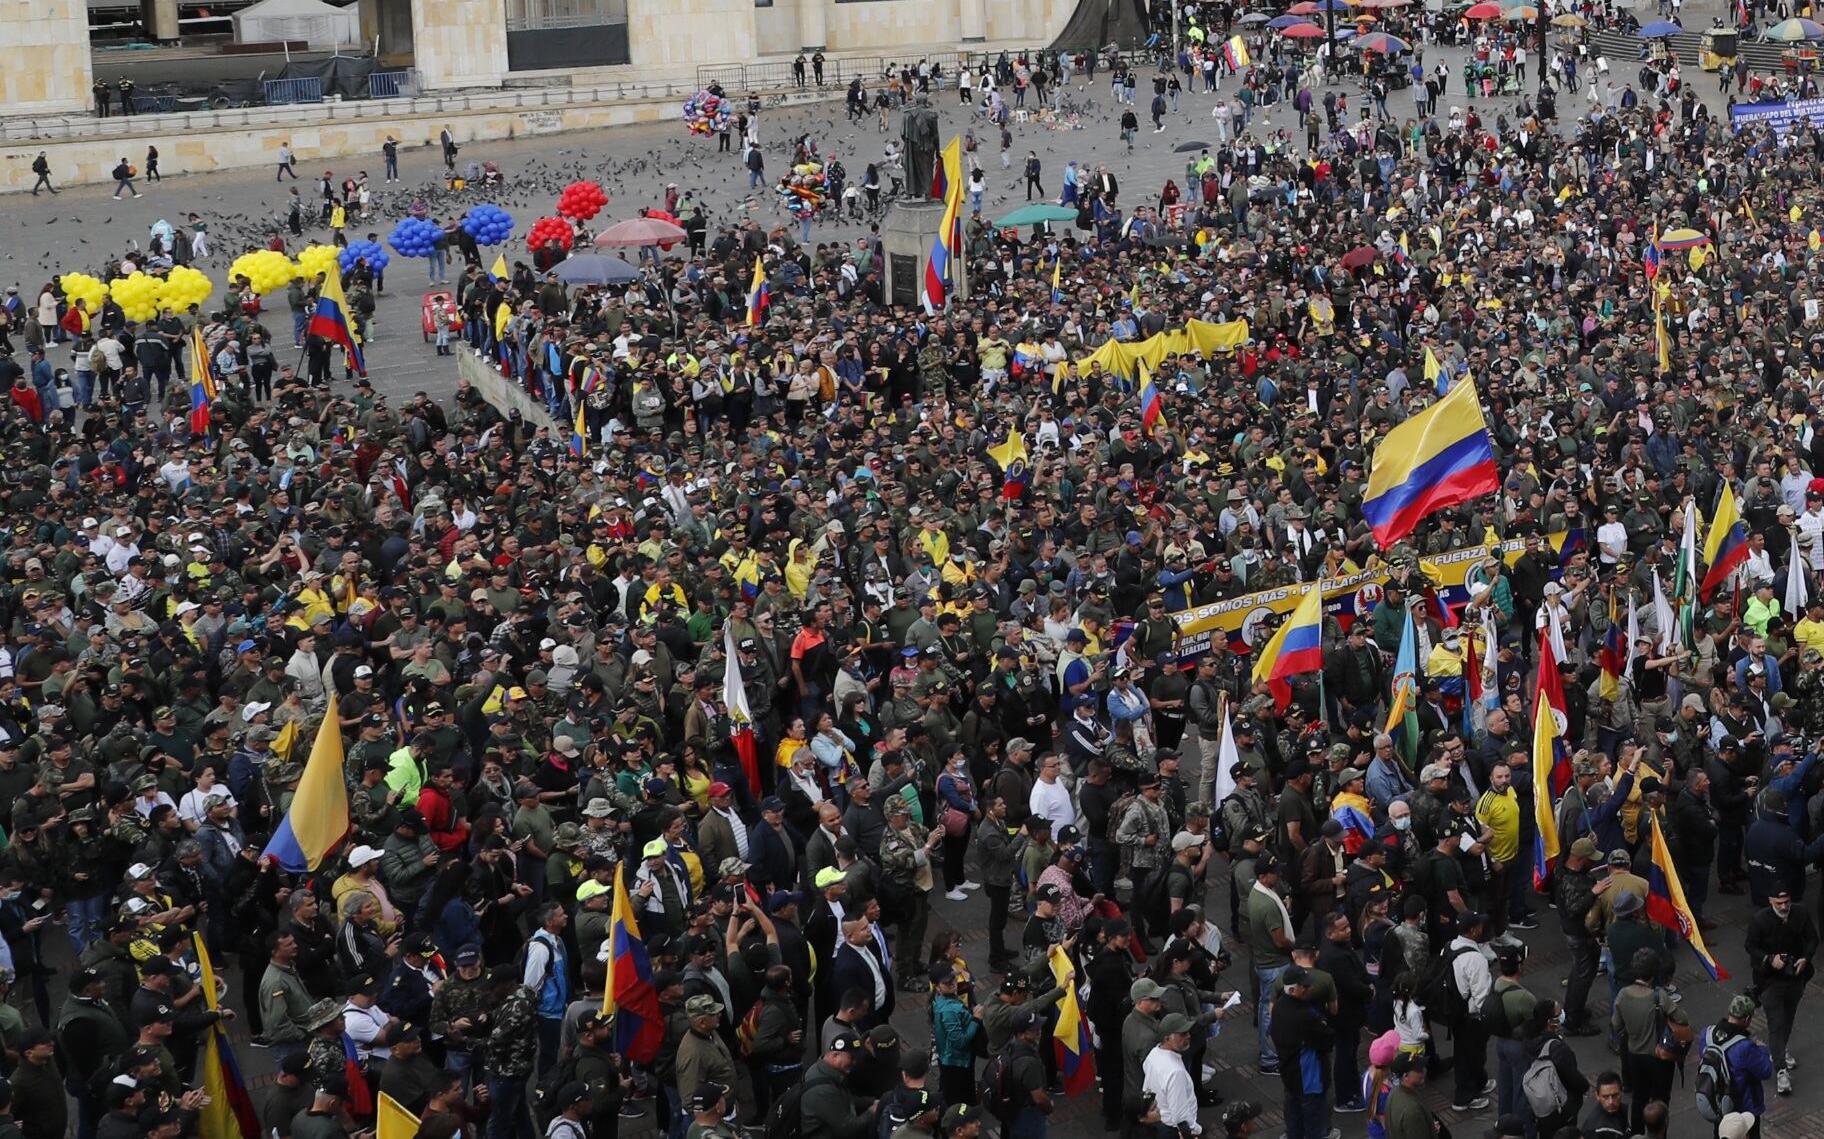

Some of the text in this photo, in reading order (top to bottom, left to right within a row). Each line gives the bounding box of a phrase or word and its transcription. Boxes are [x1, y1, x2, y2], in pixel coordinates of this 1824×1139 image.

[1198, 596, 1253, 619] SOMOS
[1435, 547, 1488, 565] FUERZA
[1181, 641, 1211, 657] LEALTAD
